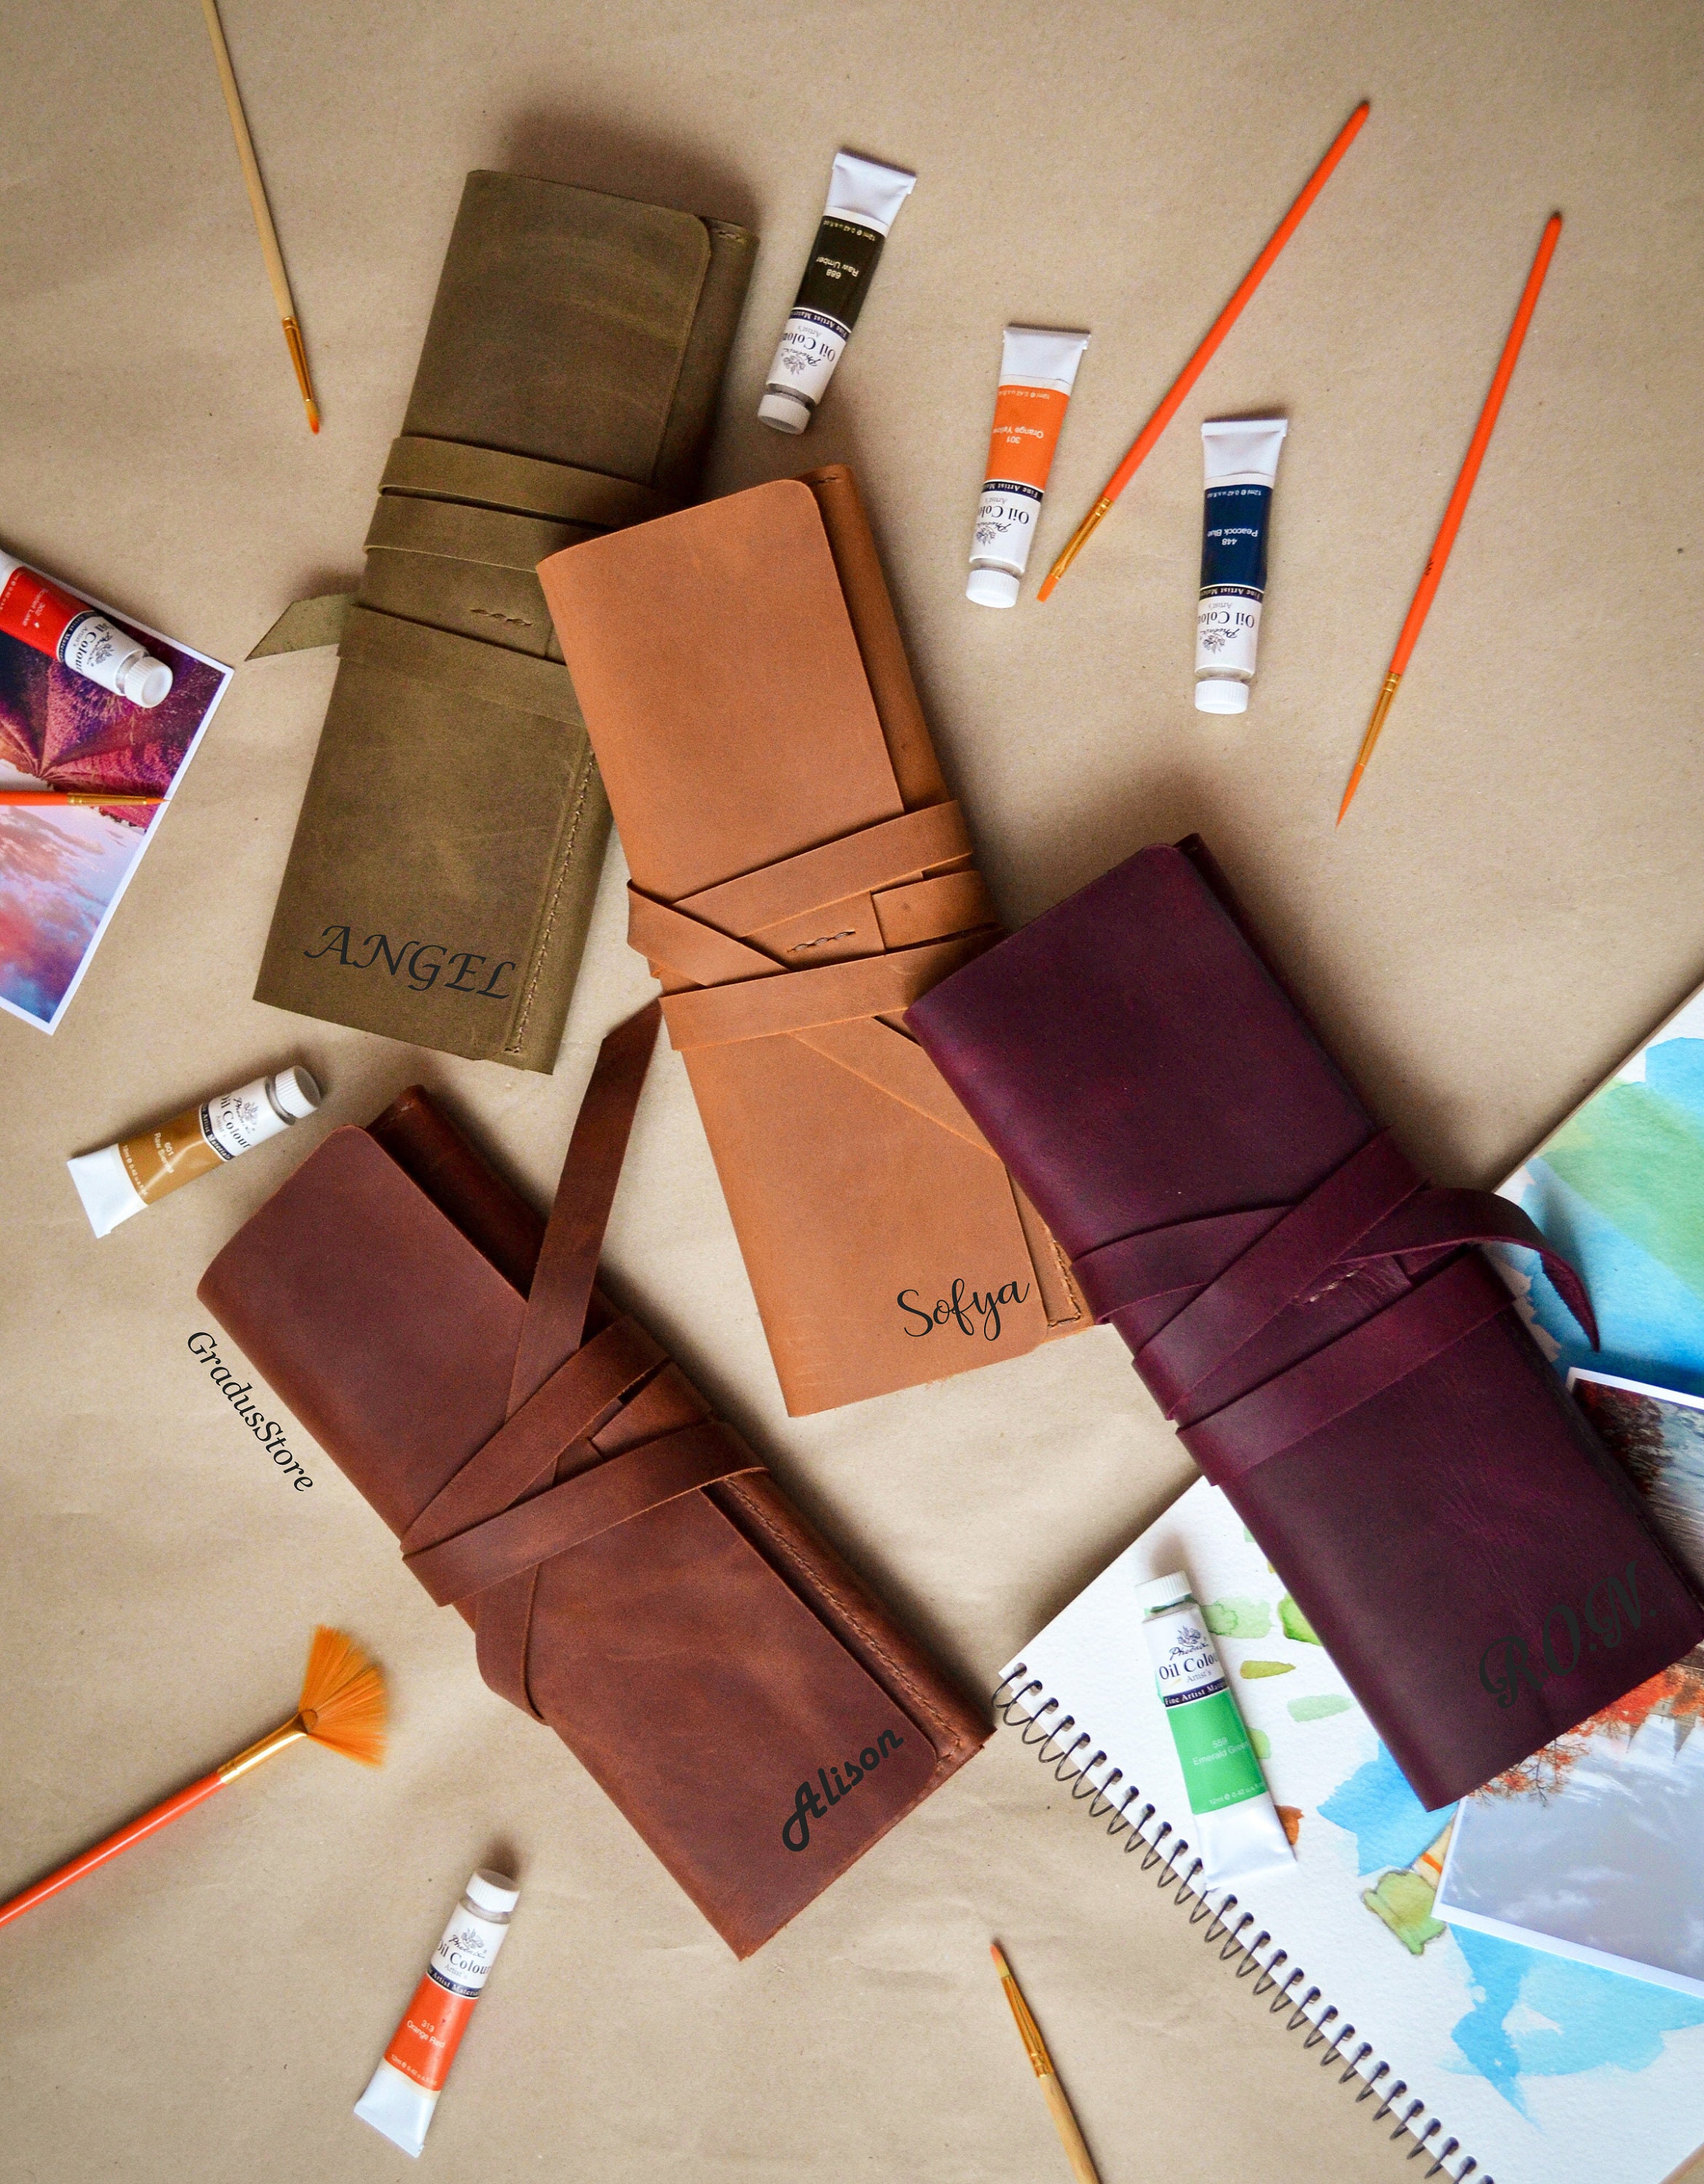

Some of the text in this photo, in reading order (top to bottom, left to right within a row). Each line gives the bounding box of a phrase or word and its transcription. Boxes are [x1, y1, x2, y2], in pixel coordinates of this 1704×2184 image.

[815, 256, 860, 277] Raw Umber
[812, 314, 836, 328] Artist
[835, 325, 847, 338] Fine
[818, 343, 836, 362] Oil
[1006, 435, 1021, 443] 301
[1014, 425, 1044, 438] Orange
[997, 483, 1021, 491] Artist
[1022, 487, 1037, 498] Fine
[1007, 507, 1029, 524] Oil
[1207, 528, 1258, 537] Peacock Blue
[1235, 612, 1254, 628] Oil
[75, 631, 96, 672] Colour
[304, 925, 516, 999] ANGEL
[223, 1110, 252, 1148] Colour
[154, 1131, 162, 1148] Raw
[206, 1133, 231, 1160] Materials
[163, 1141, 175, 1156] 601
[897, 1278, 1030, 1341] Sofya
[1159, 1662, 1181, 1679] Oil
[1164, 1697, 1179, 1705] Fine
[1182, 1688, 1205, 1701] Artist
[1192, 1748, 1227, 1765] Emerald
[782, 1729, 904, 1852] Alison
[432, 1972, 451, 1988] Artist
[407, 2019, 445, 2048] Orange Red
[421, 2019, 435, 2033] 313
